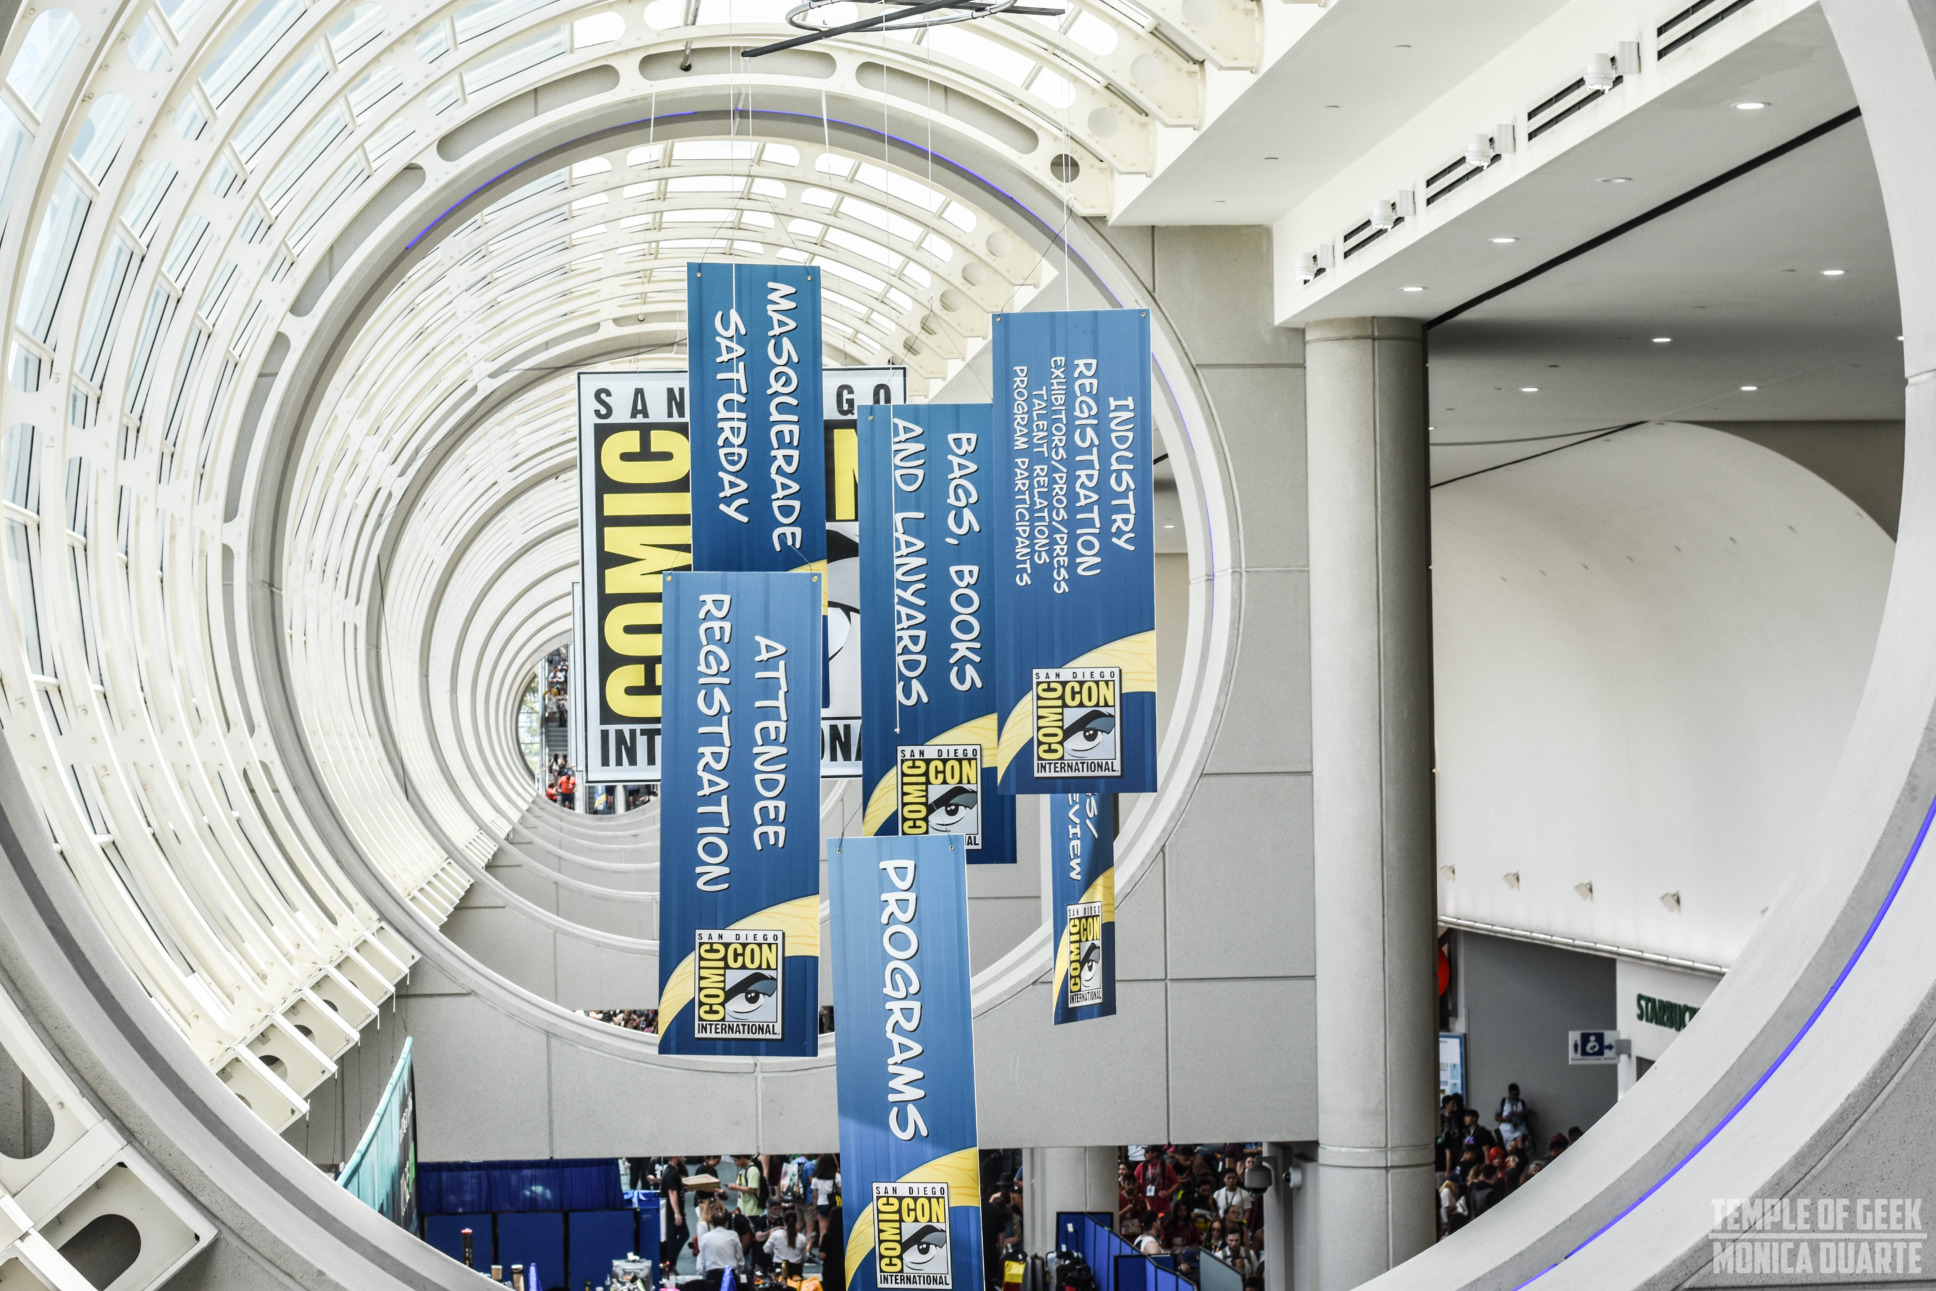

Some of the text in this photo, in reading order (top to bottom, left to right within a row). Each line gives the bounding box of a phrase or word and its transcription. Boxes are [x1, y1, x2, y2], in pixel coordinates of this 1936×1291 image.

[594, 386, 685, 419] SAN
[714, 309, 750, 523] SATURDAY
[767, 281, 802, 552] MASQUERADE
[1013, 366, 1031, 586] PROGRAM PARTICIPANTS
[1032, 386, 1050, 565] TALENT RELATIONS
[1050, 356, 1069, 594] EXHIBITORS/PROS/PRESS
[1074, 358, 1101, 577] REGISTRATION
[1109, 396, 1136, 551] INDUSTRY
[601, 430, 692, 717] COMIC
[893, 417, 929, 706] AND LANYARDS
[945, 432, 983, 691] BAGS, BOOKS
[1035, 671, 1115, 680] SAN DIEGO
[1064, 681, 1115, 707] CON
[695, 593, 732, 892] REGISTRATION
[752, 635, 788, 851] ATTENDEE
[901, 748, 978, 758] SAN DIEGO
[1037, 682, 1064, 760] COMIC
[902, 760, 927, 834] COMIC
[928, 760, 977, 785] CON
[1037, 761, 1117, 774] INTERNATIONAL
[1068, 793, 1081, 881] EVIEW
[698, 933, 724, 941] SAN
[1068, 905, 1100, 918] SAN DIEGO
[1080, 916, 1100, 942] CON
[699, 943, 725, 1021] COMIC
[727, 943, 777, 969] CON
[1069, 918, 1081, 992] COMIC
[697, 1023, 777, 1035] INTERNATIONAL
[879, 859, 929, 1141] PROGRAMS
[1069, 989, 1102, 1004] INTERNATIONAL
[1636, 993, 1700, 1032] STARBUC
[875, 1186, 945, 1195] SAN DIEGO
[901, 1197, 945, 1223] CON
[877, 1197, 902, 1273] COMIC
[879, 1274, 950, 1286] INTERNATIONAL
